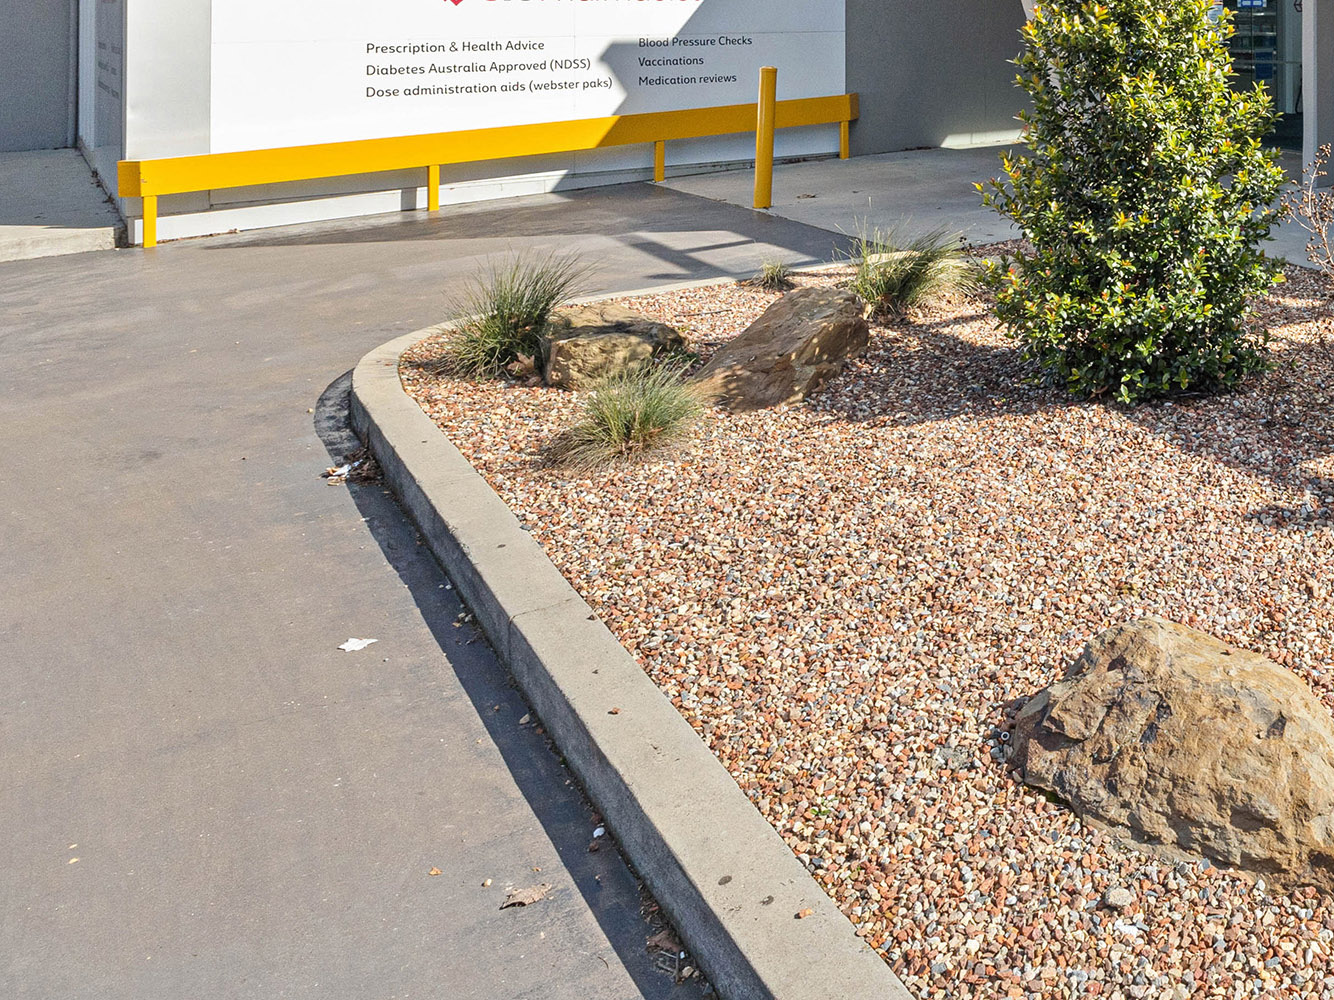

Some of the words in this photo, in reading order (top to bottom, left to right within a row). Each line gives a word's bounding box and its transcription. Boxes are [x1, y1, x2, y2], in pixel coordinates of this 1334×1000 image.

[366, 43, 446, 54] Prescription
[449, 42, 458, 52] &
[462, 41, 503, 52] Health
[505, 40, 545, 51] Advice
[638, 37, 669, 48] Blood
[672, 37, 716, 47] Pressure
[718, 36, 753, 46] Checks
[366, 64, 425, 76] Diabetes
[428, 62, 487, 74] Australia
[489, 60, 547, 73] Approved
[549, 58, 591, 71] (NDSS)
[638, 56, 704, 67] Vaccinations
[638, 75, 696, 86] Medication
[699, 74, 737, 84] reviews
[366, 86, 400, 98] Dose
[403, 83, 497, 96] administration
[501, 81, 526, 92] aids
[529, 80, 580, 92] (webster
[582, 77, 613, 90] paks)
